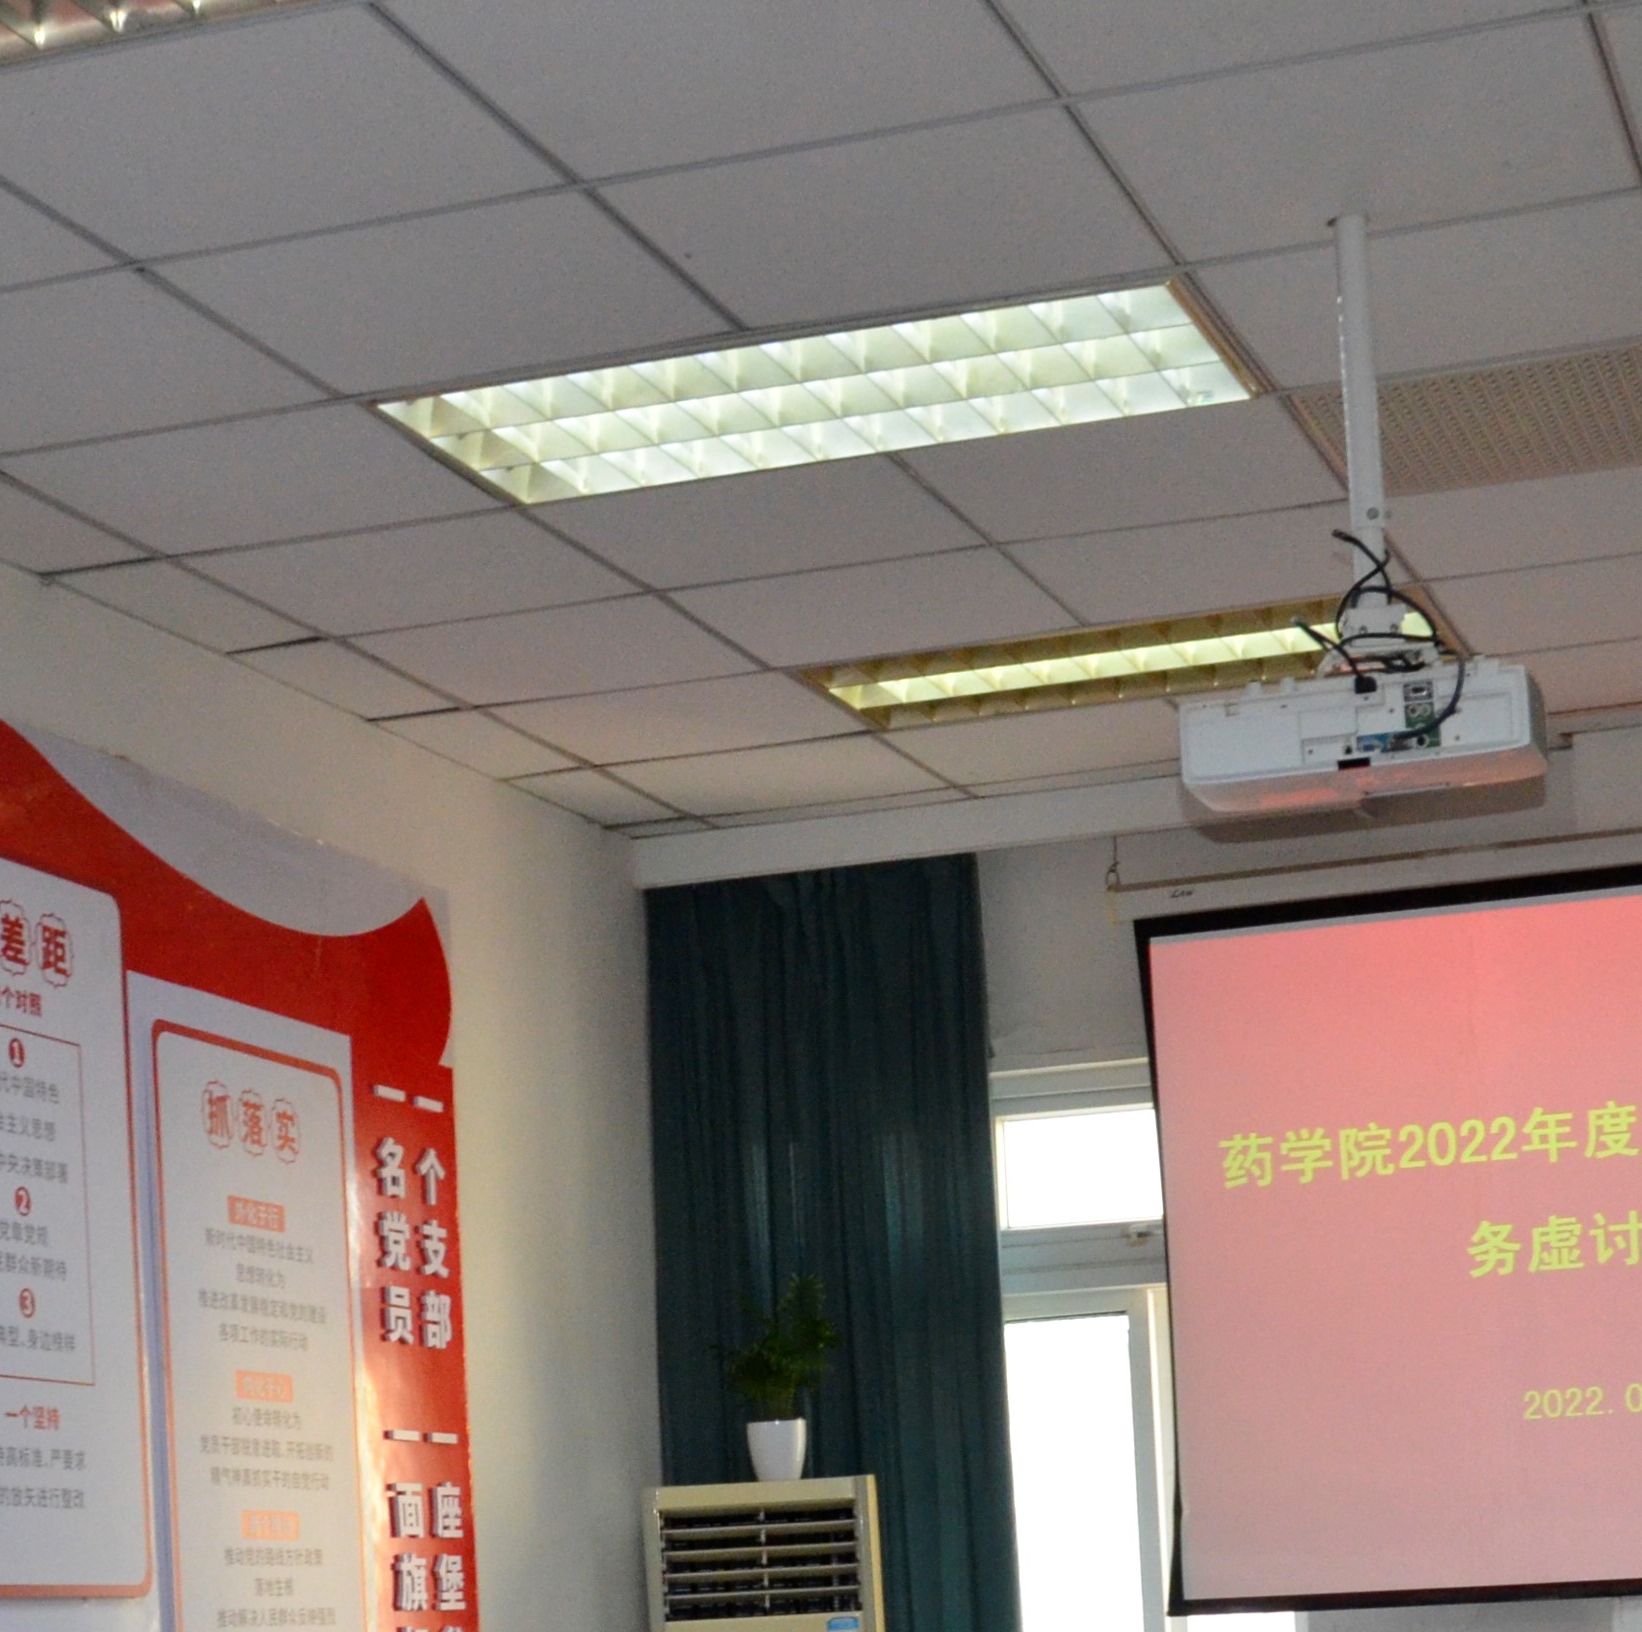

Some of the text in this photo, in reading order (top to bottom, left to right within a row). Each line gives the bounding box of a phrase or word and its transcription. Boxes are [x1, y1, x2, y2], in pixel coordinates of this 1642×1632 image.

[207, 1093, 300, 1155] 抓落实
[376, 1083, 414, 1345] 一名党员
[415, 1095, 452, 1350] 一个支部
